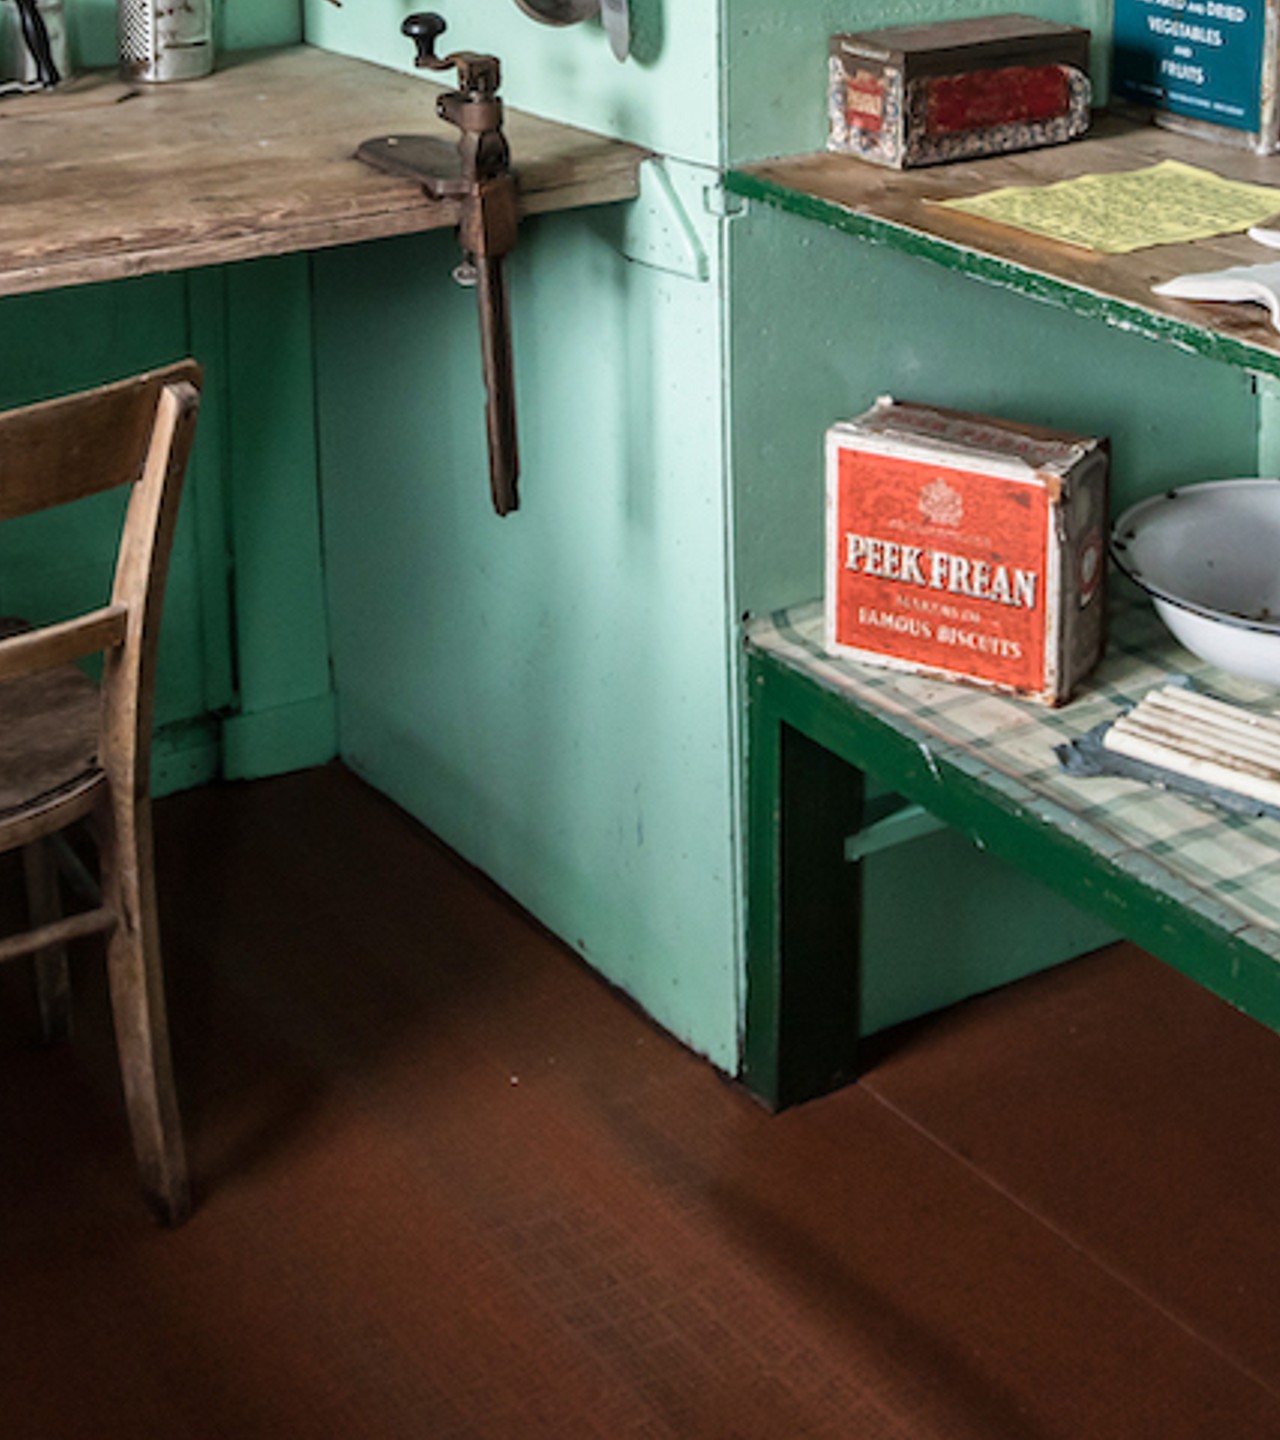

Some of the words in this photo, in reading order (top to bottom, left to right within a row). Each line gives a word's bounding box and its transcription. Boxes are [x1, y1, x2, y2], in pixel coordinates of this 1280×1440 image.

[1207, 0, 1247, 23] DRIED
[1147, 15, 1223, 47] VEGETABLES
[1162, 60, 1204, 85] FRUITS
[845, 532, 926, 586] PEEK
[927, 546, 1037, 609] FREAN
[858, 606, 932, 638] FAMOUS
[936, 624, 1023, 660] BISCUITS
